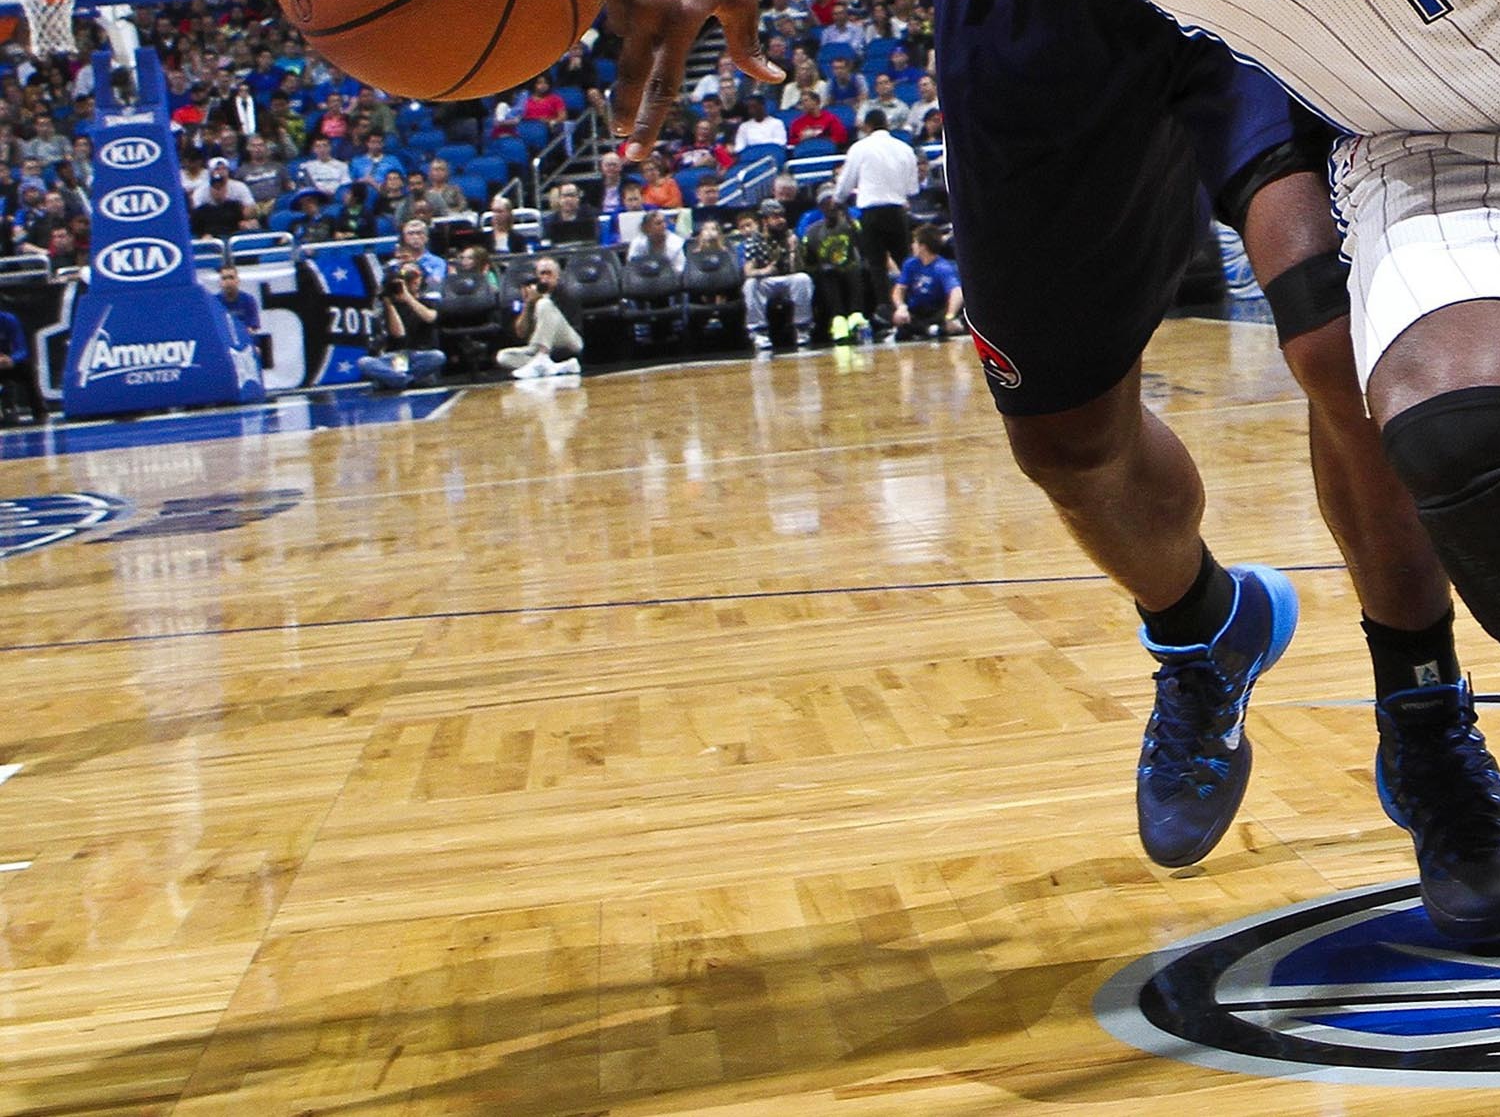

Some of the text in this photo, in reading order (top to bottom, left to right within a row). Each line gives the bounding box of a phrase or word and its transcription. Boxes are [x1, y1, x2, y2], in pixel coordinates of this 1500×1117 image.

[109, 144, 151, 164] KIA
[111, 193, 160, 215] KIA
[110, 244, 169, 274] KIA
[91, 339, 197, 370] Amway
[125, 368, 182, 384] CENTER
